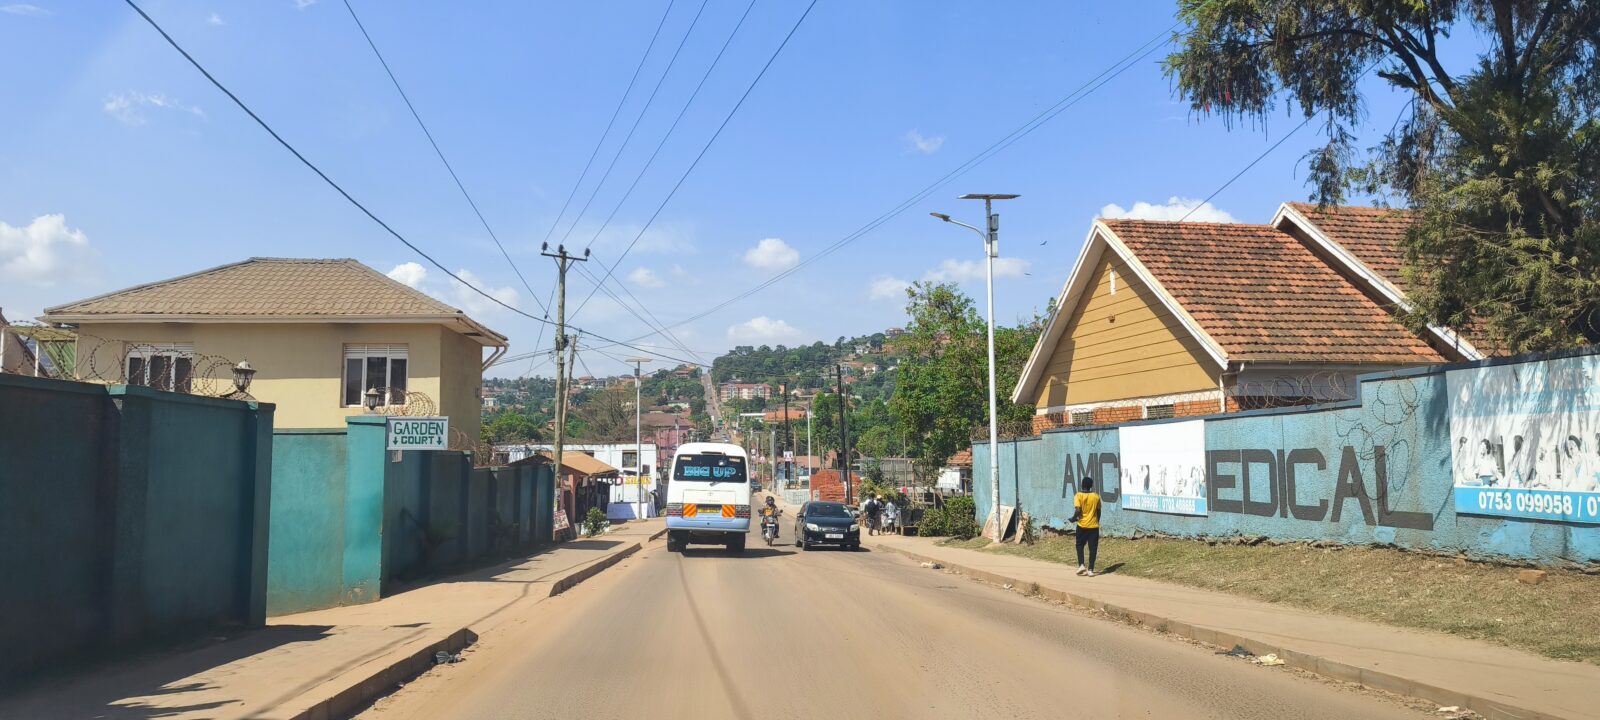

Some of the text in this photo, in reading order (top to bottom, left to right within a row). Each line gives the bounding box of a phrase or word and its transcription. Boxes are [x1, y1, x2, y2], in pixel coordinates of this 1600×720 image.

[394, 422, 444, 435] GARDEN
[401, 436, 434, 445] COURT
[684, 466, 736, 477] BIG UP
[1062, 446, 1433, 531] AMIC EDICAL
[1478, 491, 1600, 518] 0753 099058 / 0
